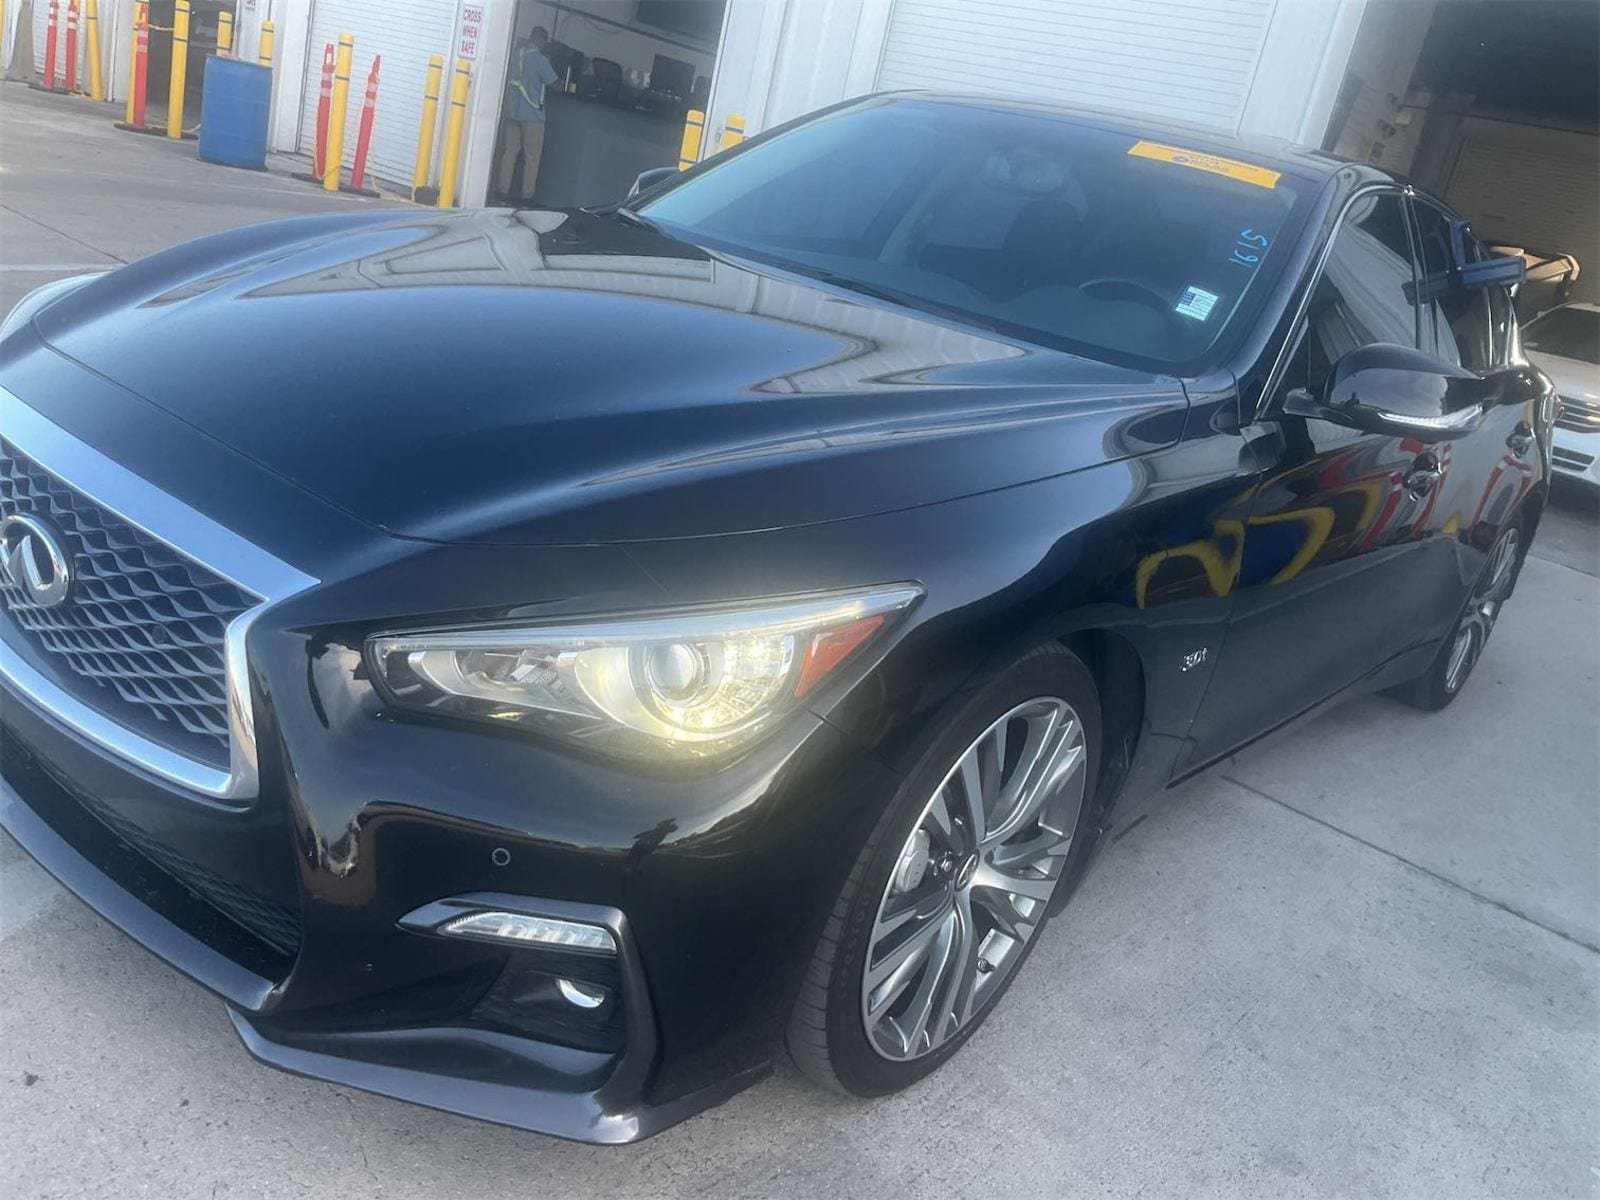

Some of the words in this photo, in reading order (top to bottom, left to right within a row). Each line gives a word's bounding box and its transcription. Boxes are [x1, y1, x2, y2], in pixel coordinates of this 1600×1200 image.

[463, 9, 481, 23] CROSS
[463, 25, 478, 38] WHEN
[461, 40, 475, 54] SAFE
